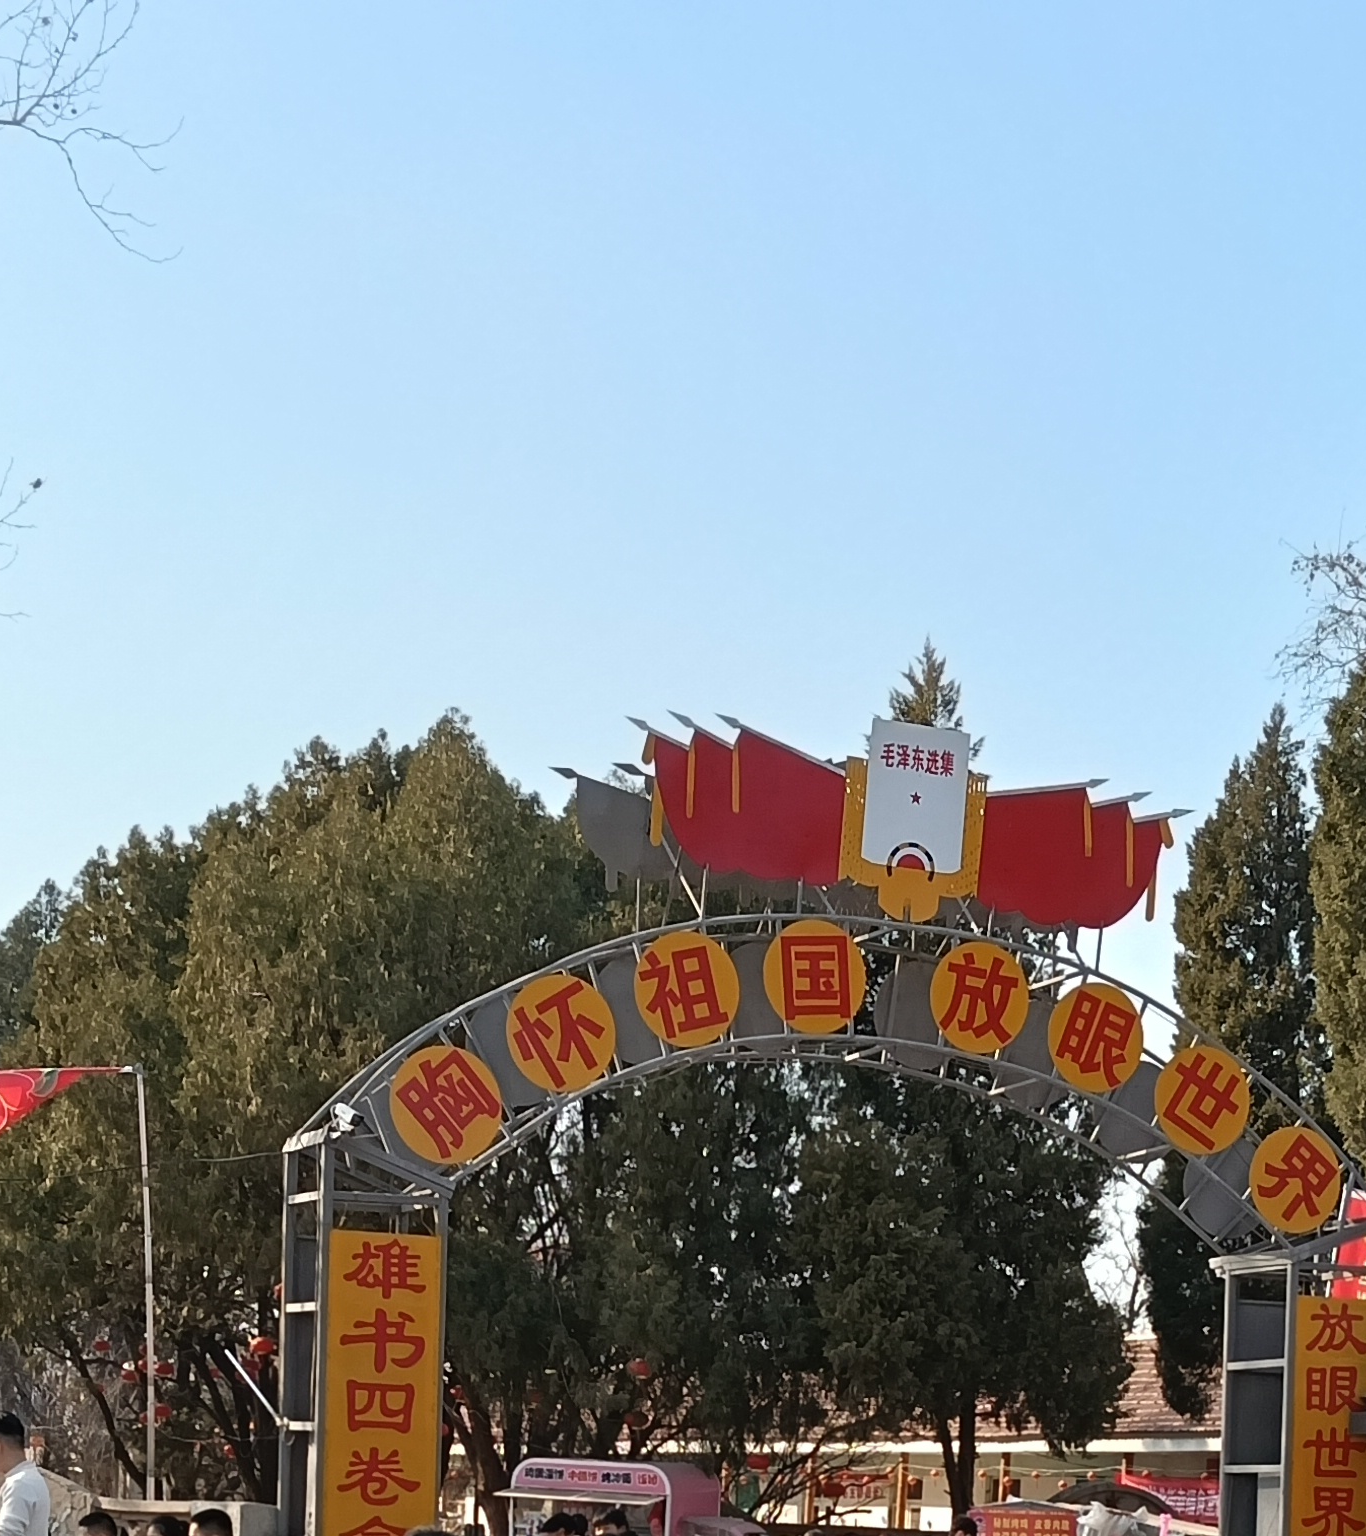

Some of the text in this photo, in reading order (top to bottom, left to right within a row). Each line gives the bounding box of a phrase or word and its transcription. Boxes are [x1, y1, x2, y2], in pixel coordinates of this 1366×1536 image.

[880, 743, 955, 777] 毛泽东选集
[393, 932, 1341, 1222] 胸怀祖国放眼世界
